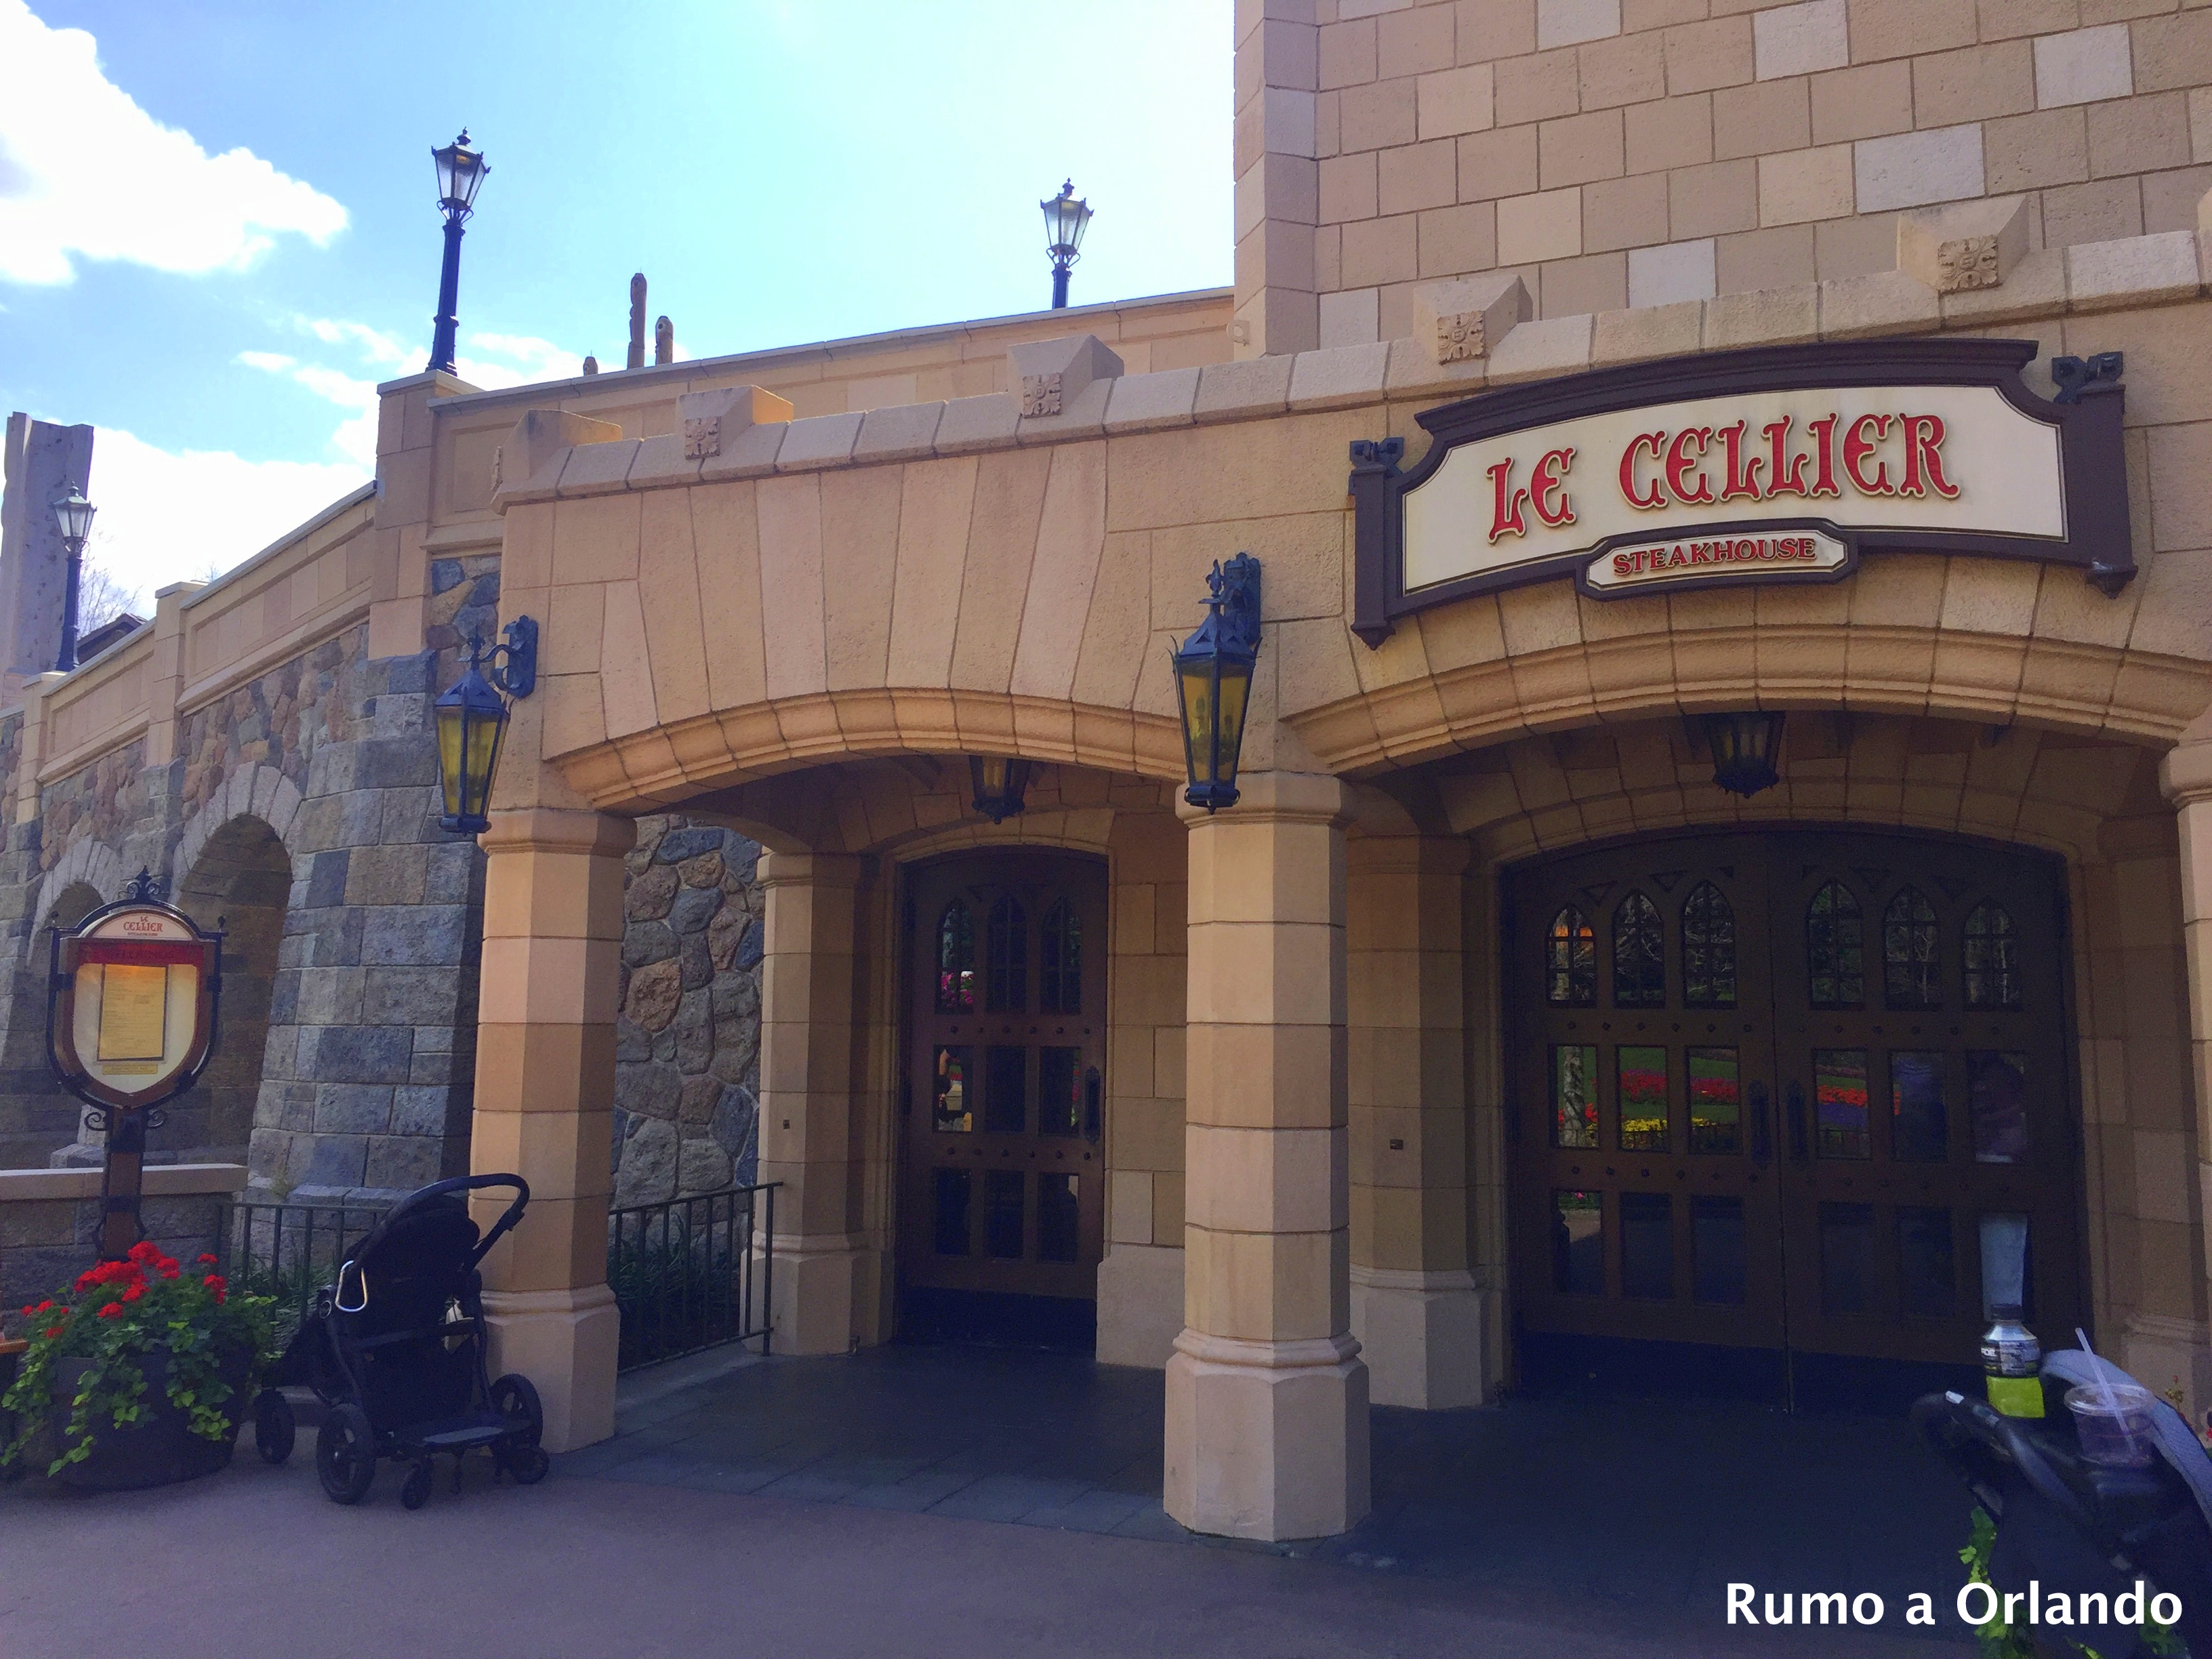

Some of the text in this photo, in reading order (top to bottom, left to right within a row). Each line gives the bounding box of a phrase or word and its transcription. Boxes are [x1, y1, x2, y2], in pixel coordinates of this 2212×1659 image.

[1486, 413, 1960, 541] LE CELLIER
[1612, 537, 1817, 576] STEAKHOUSE
[123, 921, 163, 933] CELLIER
